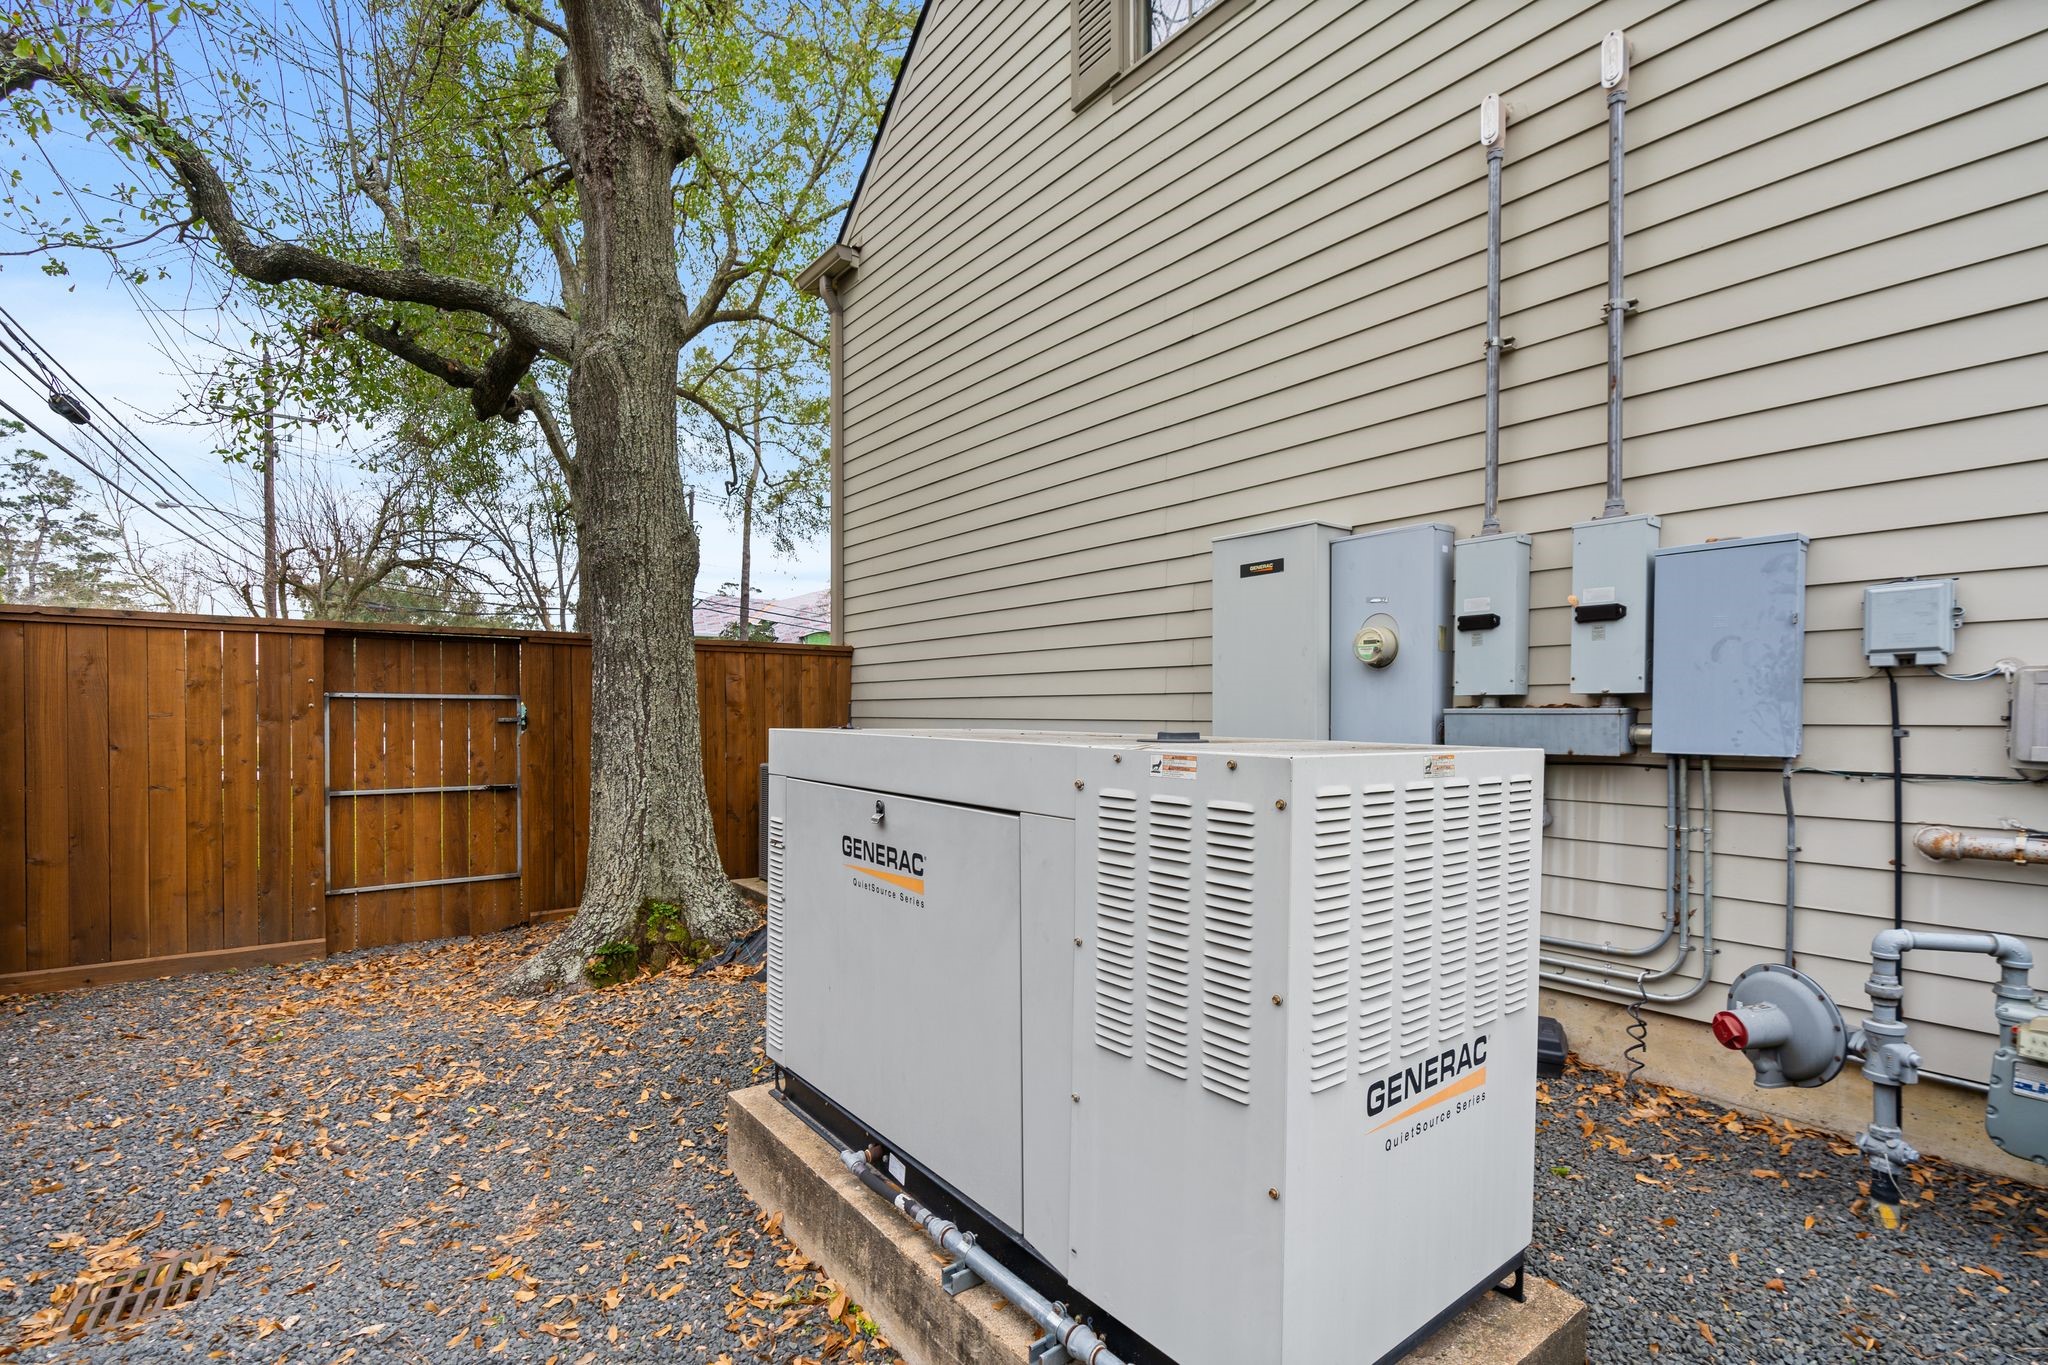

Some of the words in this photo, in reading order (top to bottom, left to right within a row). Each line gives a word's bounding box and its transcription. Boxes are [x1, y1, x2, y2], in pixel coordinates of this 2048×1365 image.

[842, 835, 924, 877] GENERAC
[852, 877, 896, 899] QuietSource
[899, 892, 925, 909] Series
[1366, 1035, 1487, 1117] GENERAC
[1385, 1109, 1451, 1152] QuietSource
[1456, 1092, 1486, 1114] Series
